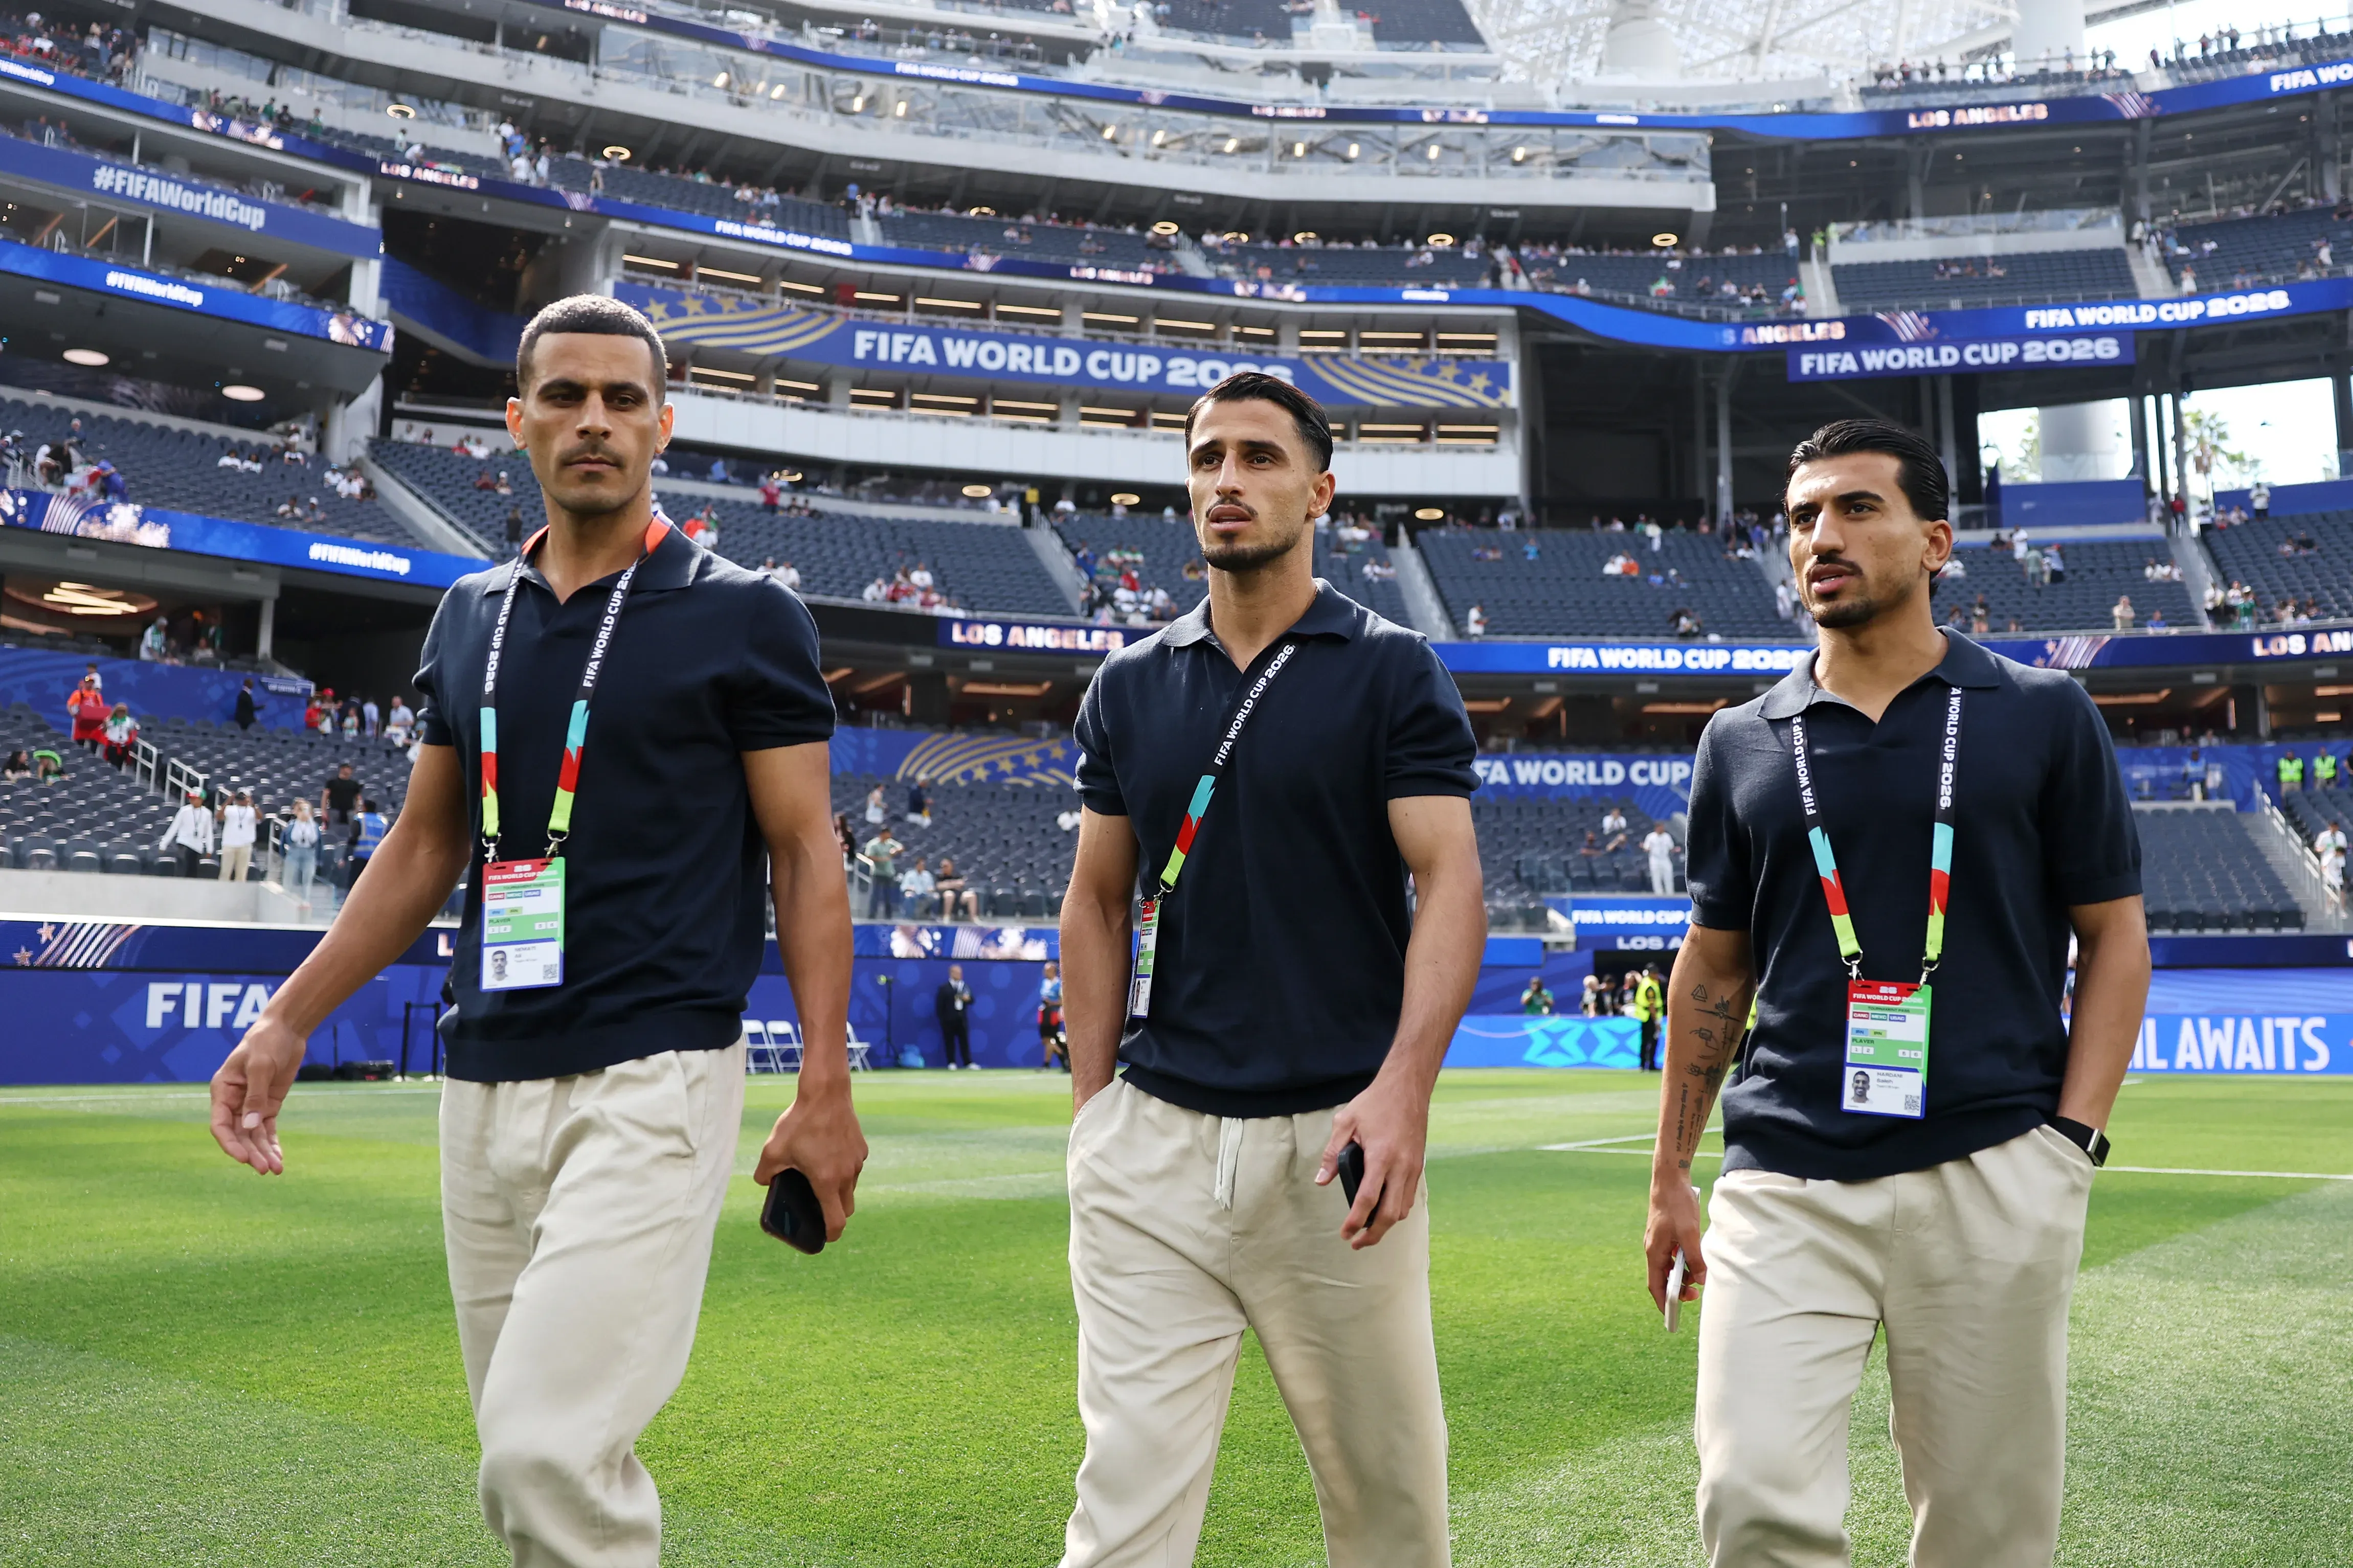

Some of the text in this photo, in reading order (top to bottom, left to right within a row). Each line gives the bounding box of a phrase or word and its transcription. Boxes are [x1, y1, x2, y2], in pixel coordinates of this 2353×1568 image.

[2270, 69, 2318, 92] FIFA
[1909, 103, 2049, 129] LOS ANGELES
[380, 161, 479, 190] LOS ANGELES
[93, 165, 266, 232] #FIFAWorldCup
[715, 220, 742, 237] FIFA
[742, 224, 787, 244] WORLD
[786, 233, 811, 247] CUP
[105, 270, 204, 308] #FIFAWorldCup
[2026, 289, 2290, 329] FIFA WORLD CUP 2026
[1741, 321, 1846, 345] ANGELES
[854, 329, 938, 366] FIFA
[942, 337, 1082, 377] WORLD
[1086, 349, 1162, 383] CUP
[1801, 337, 2121, 375] FIFA WORLD CUP 2026
[308, 542, 411, 576] #FIFAWorldCup
[497, 585, 517, 625] WORLD
[492, 626, 505, 649] CUP
[582, 660, 600, 688] FIFA
[591, 616, 614, 660] WORLD
[607, 590, 624, 615] CUP
[952, 622, 1124, 651] LOS ANGELES
[2252, 633, 2306, 657] LOS
[484, 650, 500, 694] 2026
[1548, 646, 1599, 669] FIFA
[1599, 647, 1683, 669] WORLD
[1684, 648, 1731, 670] CUP
[1214, 644, 1295, 766] FIFA WORLD CUP 2026
[1946, 694, 1962, 736] WORLD
[1792, 725, 1804, 744] CUP
[1943, 736, 1957, 761] CUP
[1512, 759, 1626, 786] WORLD
[1628, 760, 1691, 786] CUP
[1794, 746, 1810, 788] WORLD
[1801, 787, 1817, 815] FIFA
[1939, 762, 1954, 810] 2026
[1571, 910, 1604, 924] FIFA
[1603, 910, 1656, 924] WORLD
[1655, 910, 1686, 925] CUP
[1616, 936, 1665, 950] LOS
[146, 982, 270, 1029] FIFA
[2174, 1016, 2330, 1072] AWAITS
